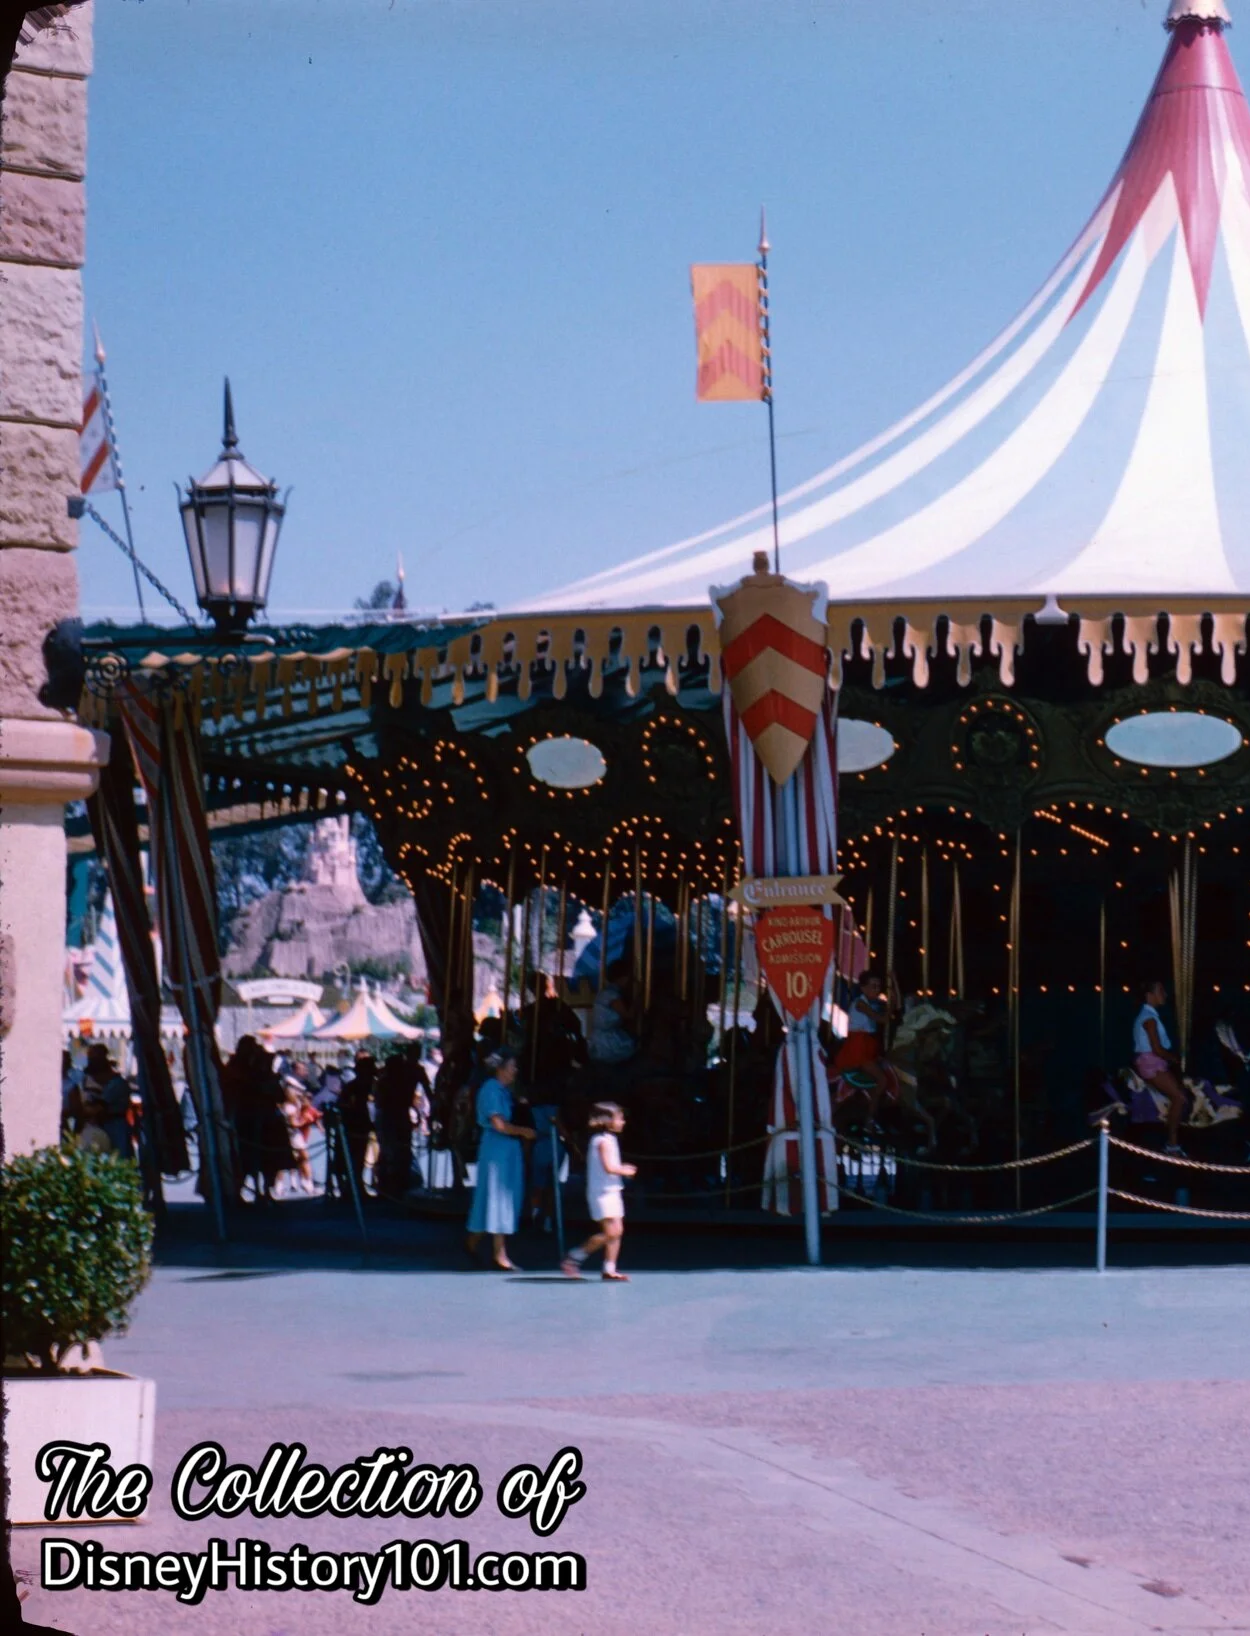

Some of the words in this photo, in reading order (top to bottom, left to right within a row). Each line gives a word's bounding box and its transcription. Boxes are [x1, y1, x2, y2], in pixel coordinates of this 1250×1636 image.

[744, 879, 826, 904] Entrance
[762, 929, 823, 952] CARROUSEL
[768, 953, 822, 964] ADMISSION
